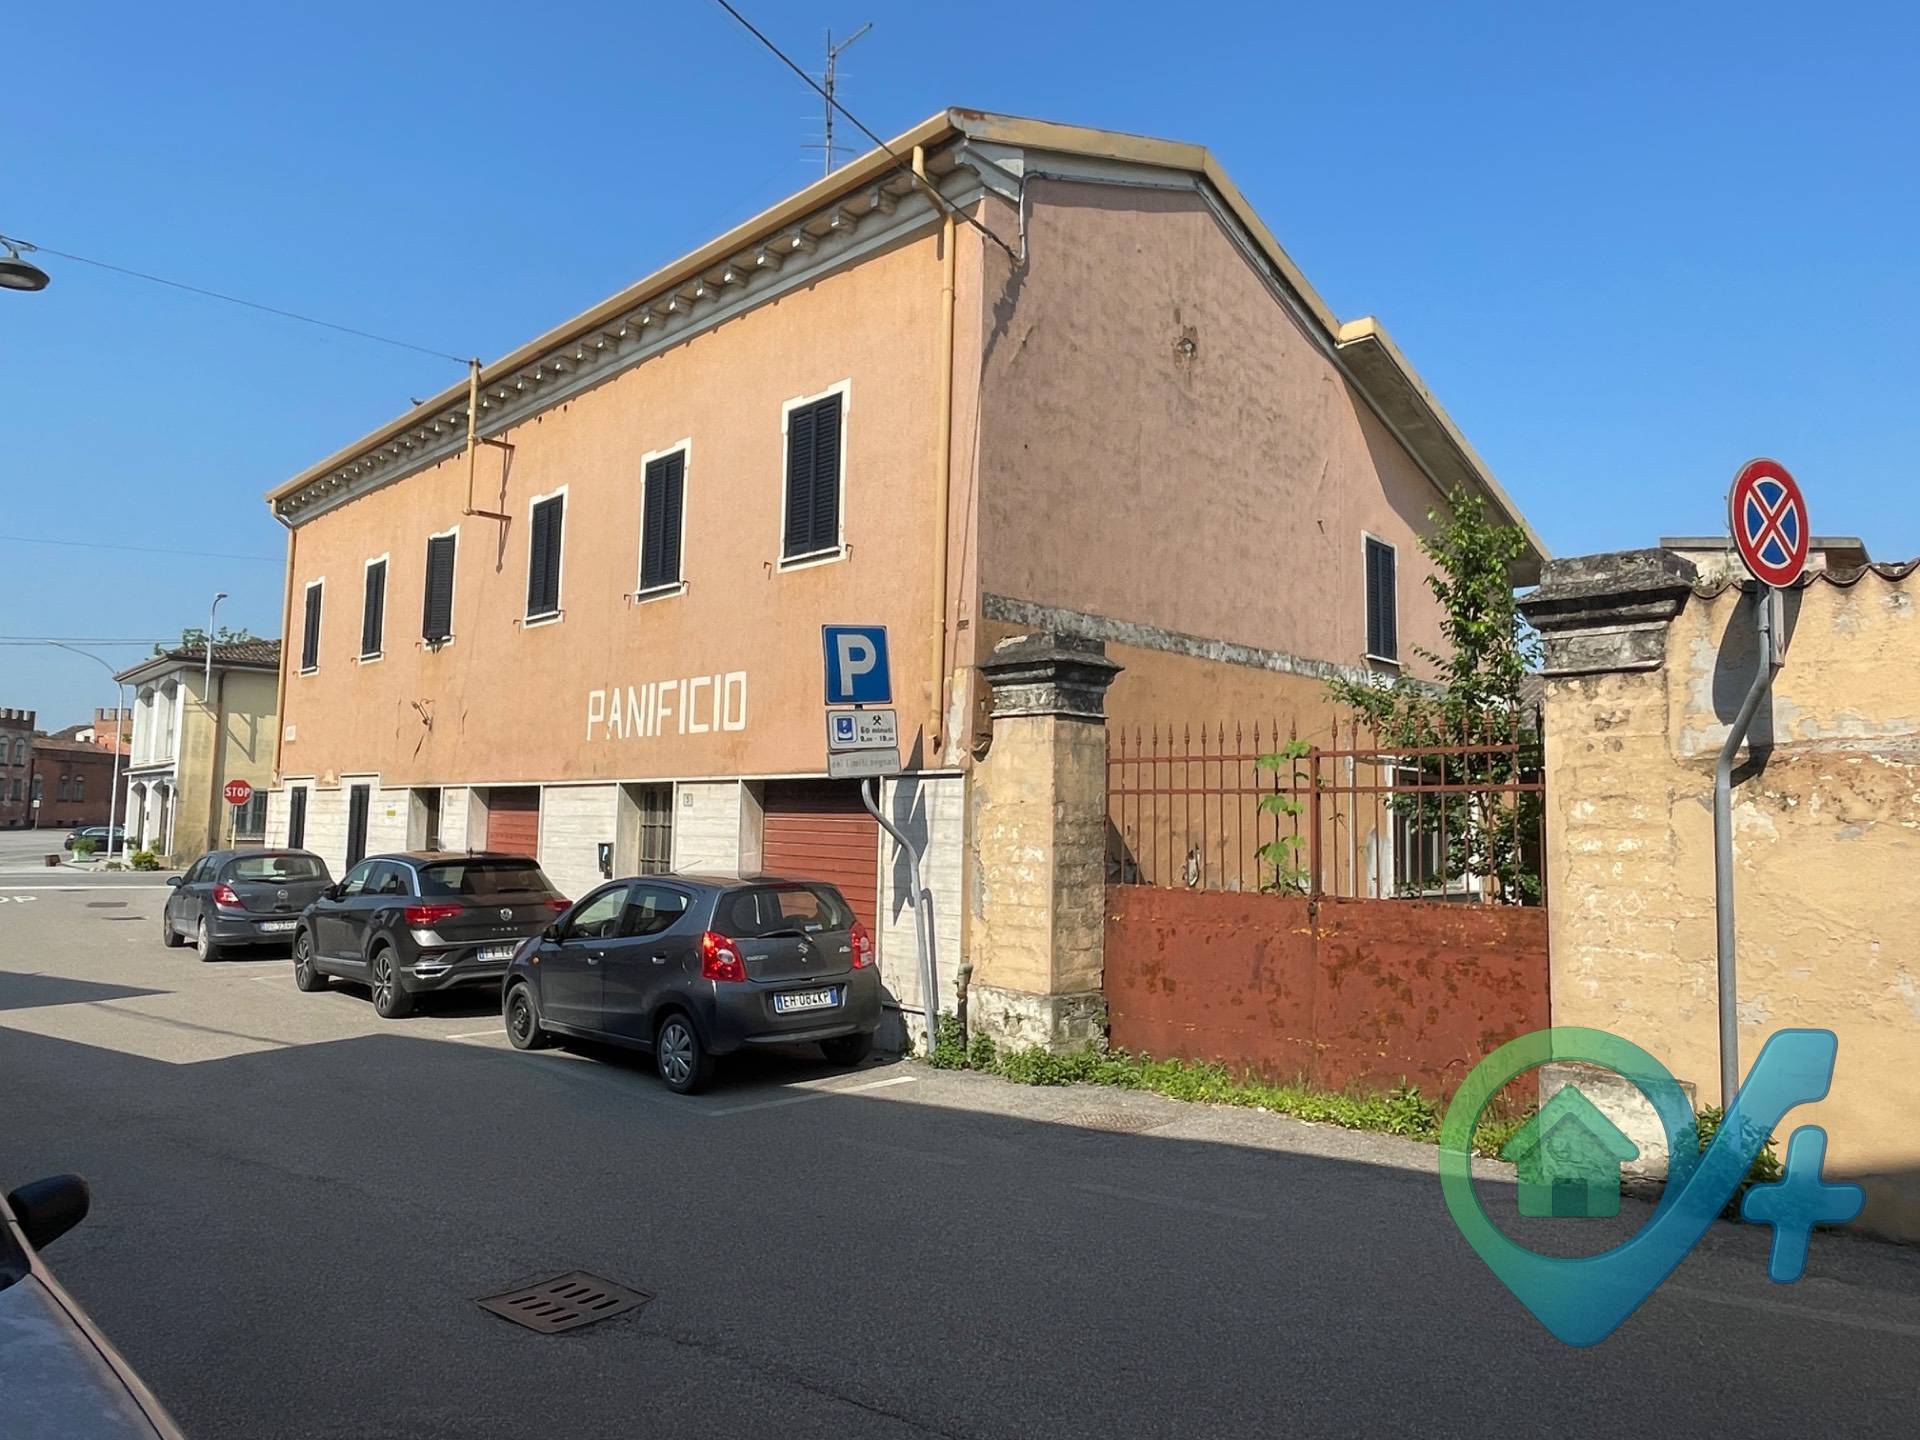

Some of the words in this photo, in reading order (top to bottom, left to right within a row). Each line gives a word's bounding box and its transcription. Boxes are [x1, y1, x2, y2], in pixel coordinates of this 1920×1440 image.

[836, 633, 877, 696] P
[586, 670, 747, 741] PANIFICIO
[225, 786, 251, 797] STOP
